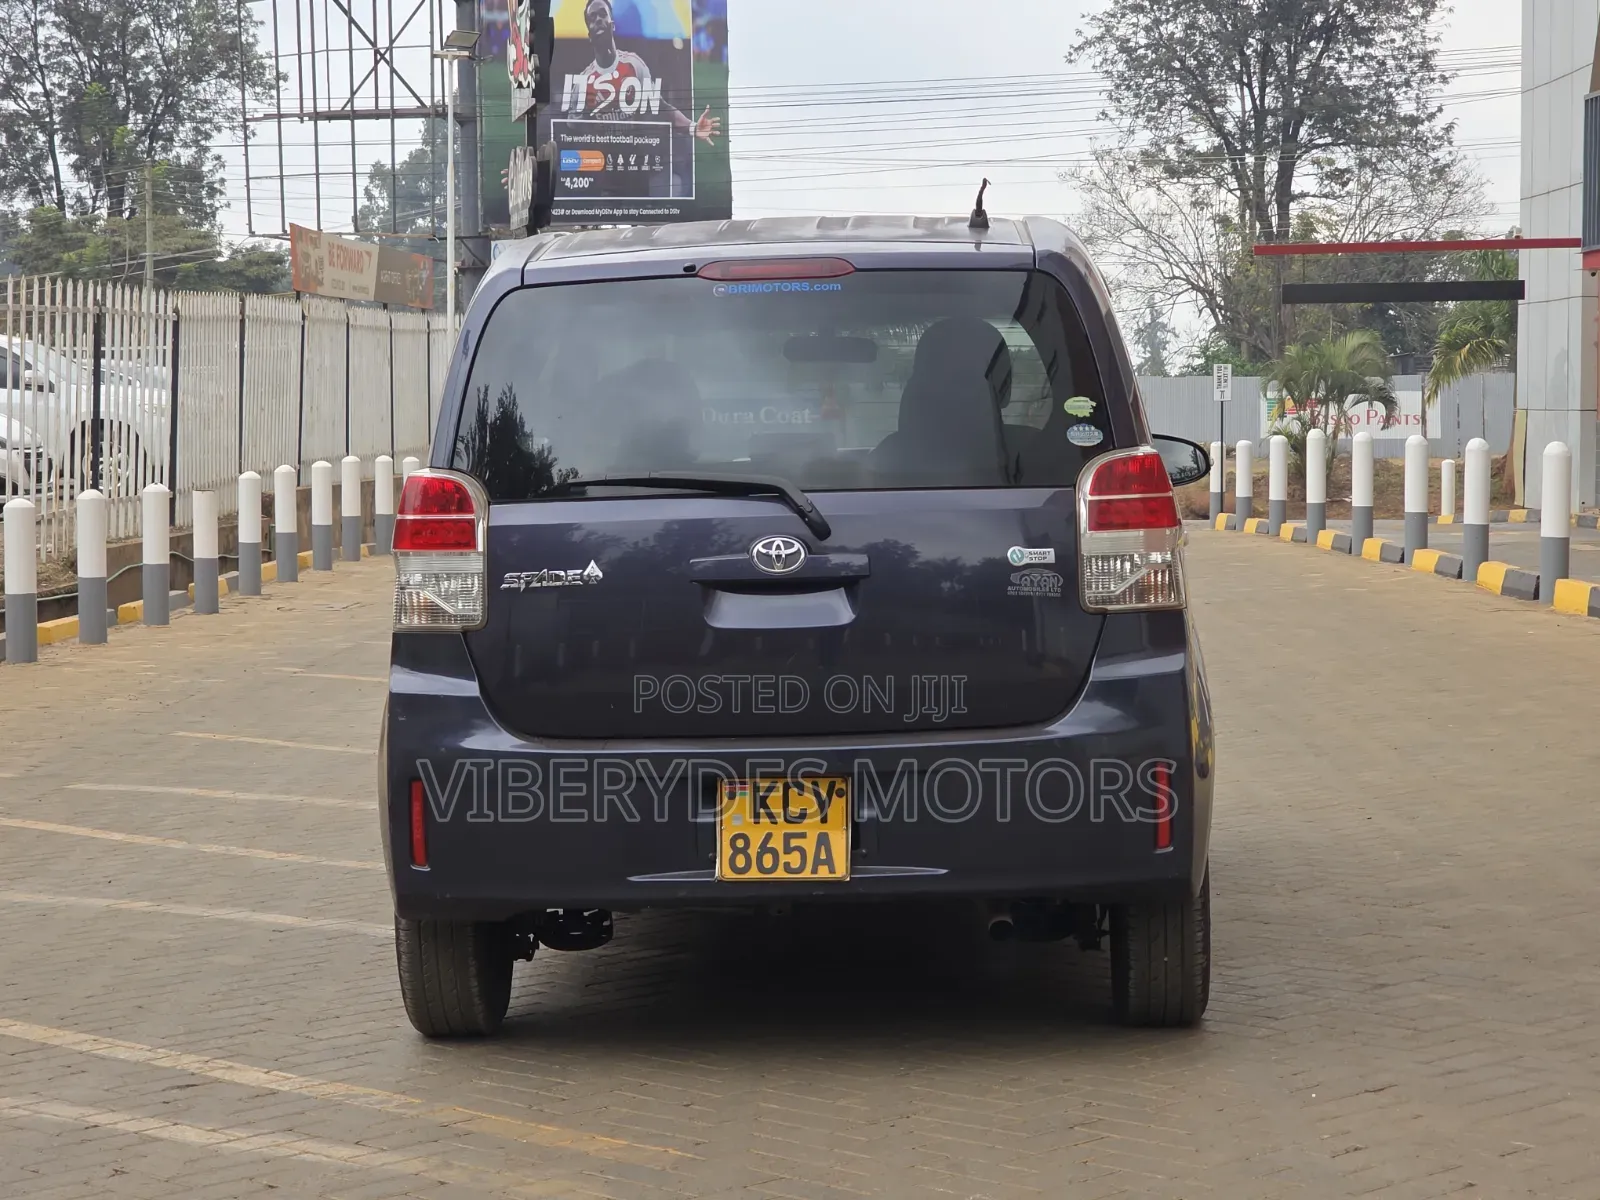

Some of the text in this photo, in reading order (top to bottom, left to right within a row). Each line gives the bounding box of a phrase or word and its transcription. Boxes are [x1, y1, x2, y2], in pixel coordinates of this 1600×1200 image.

[619, 76, 662, 114] ON
[561, 134, 660, 147] The world's best football package
[565, 177, 590, 189] 4,200
[571, 208, 595, 216] Download
[613, 208, 622, 217] App
[760, 406, 813, 425] Coat
[753, 781, 836, 825] KCY
[728, 832, 836, 875] 865A
